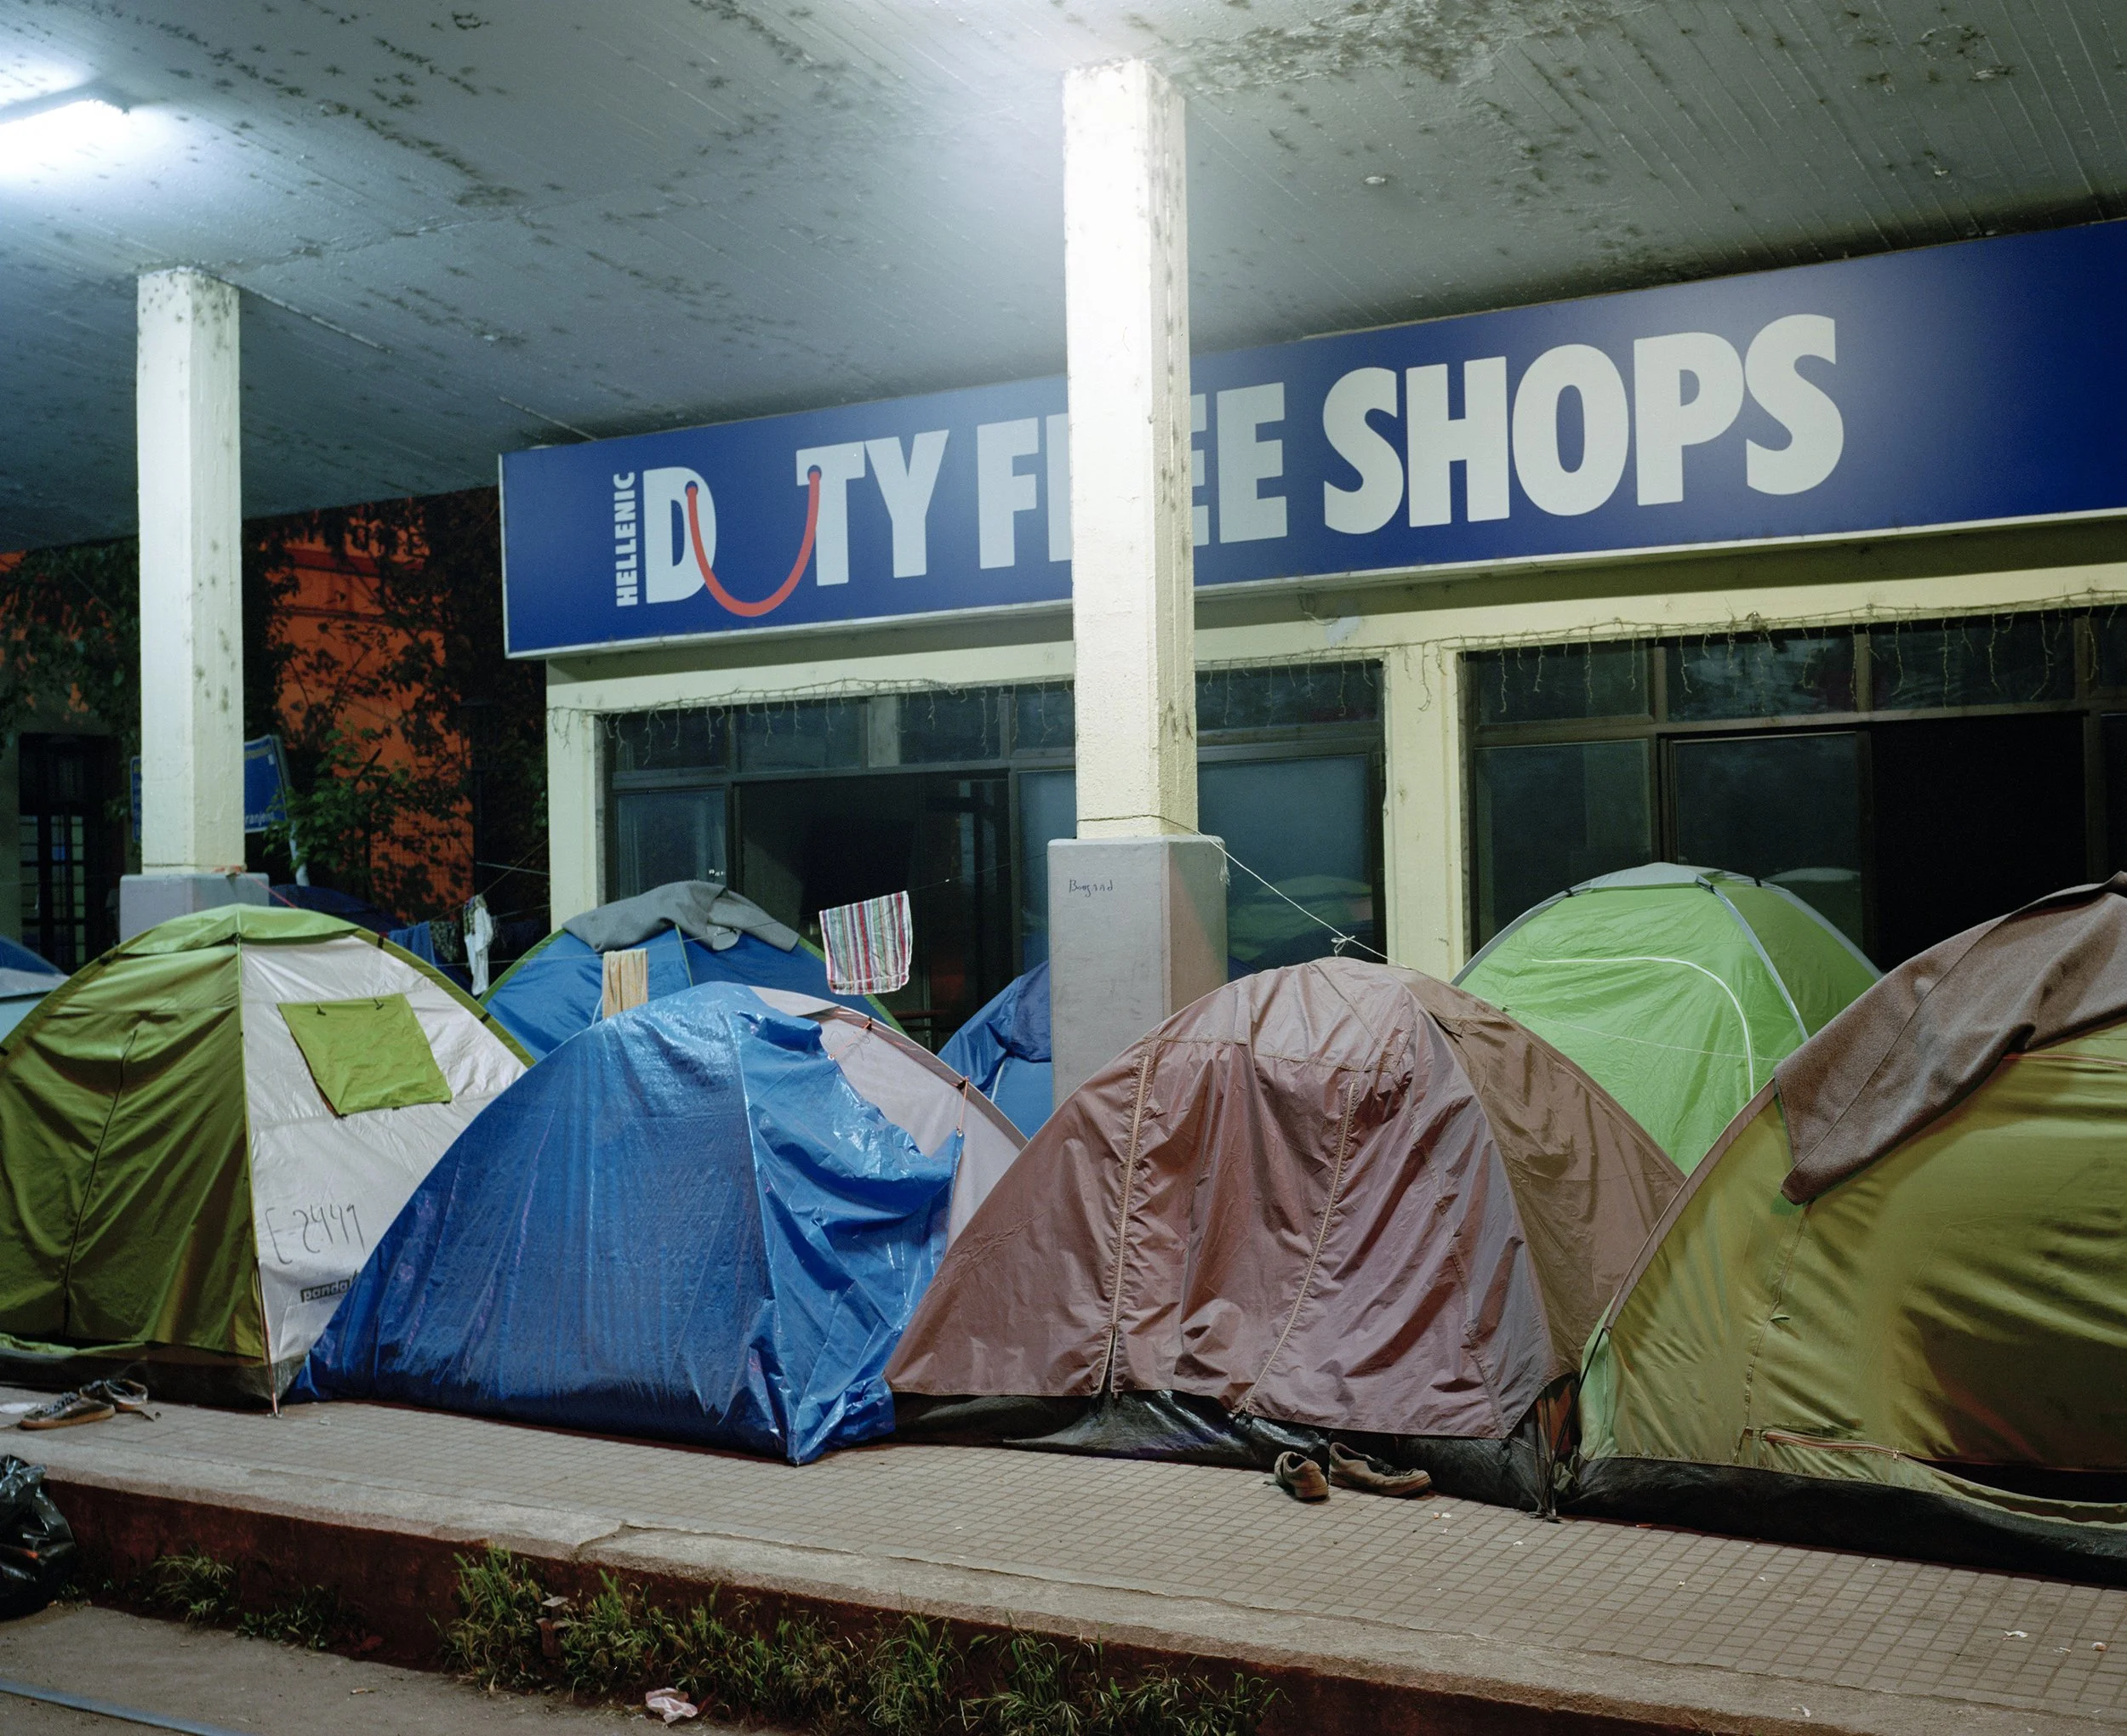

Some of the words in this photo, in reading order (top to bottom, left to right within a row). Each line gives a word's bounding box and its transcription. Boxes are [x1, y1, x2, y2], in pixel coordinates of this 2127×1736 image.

[613, 472, 638, 607] HELLENIC
[642, 430, 949, 618] DUTY
[976, 383, 1287, 572] FE
[1322, 314, 1845, 535] SHOPS
